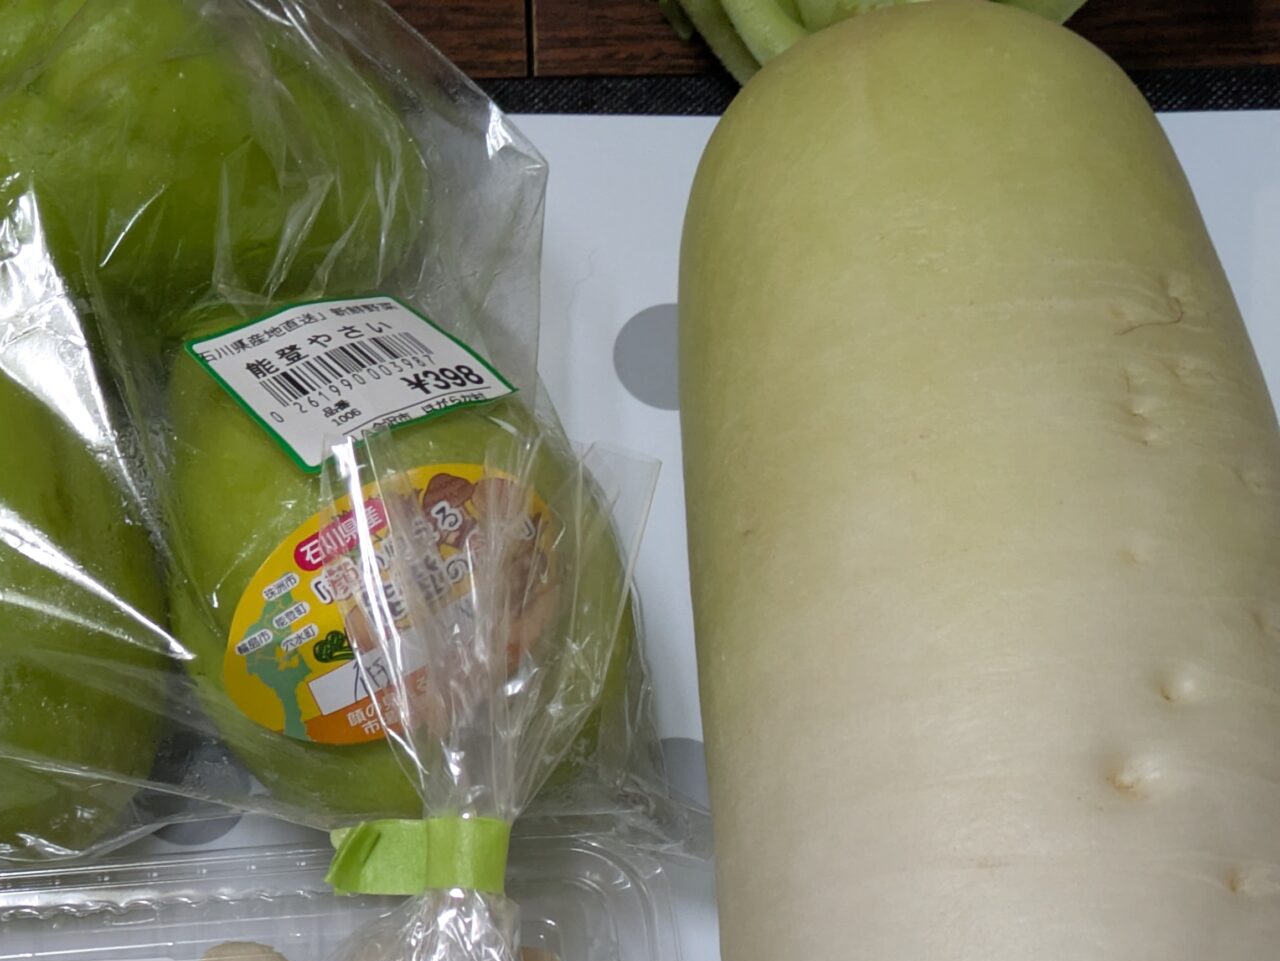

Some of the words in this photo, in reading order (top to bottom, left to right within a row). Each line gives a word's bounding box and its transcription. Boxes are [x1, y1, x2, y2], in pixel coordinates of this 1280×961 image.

[245, 321, 393, 380] 能登やさい
[399, 364, 485, 395] ¥398
[331, 408, 362, 427] 1006
